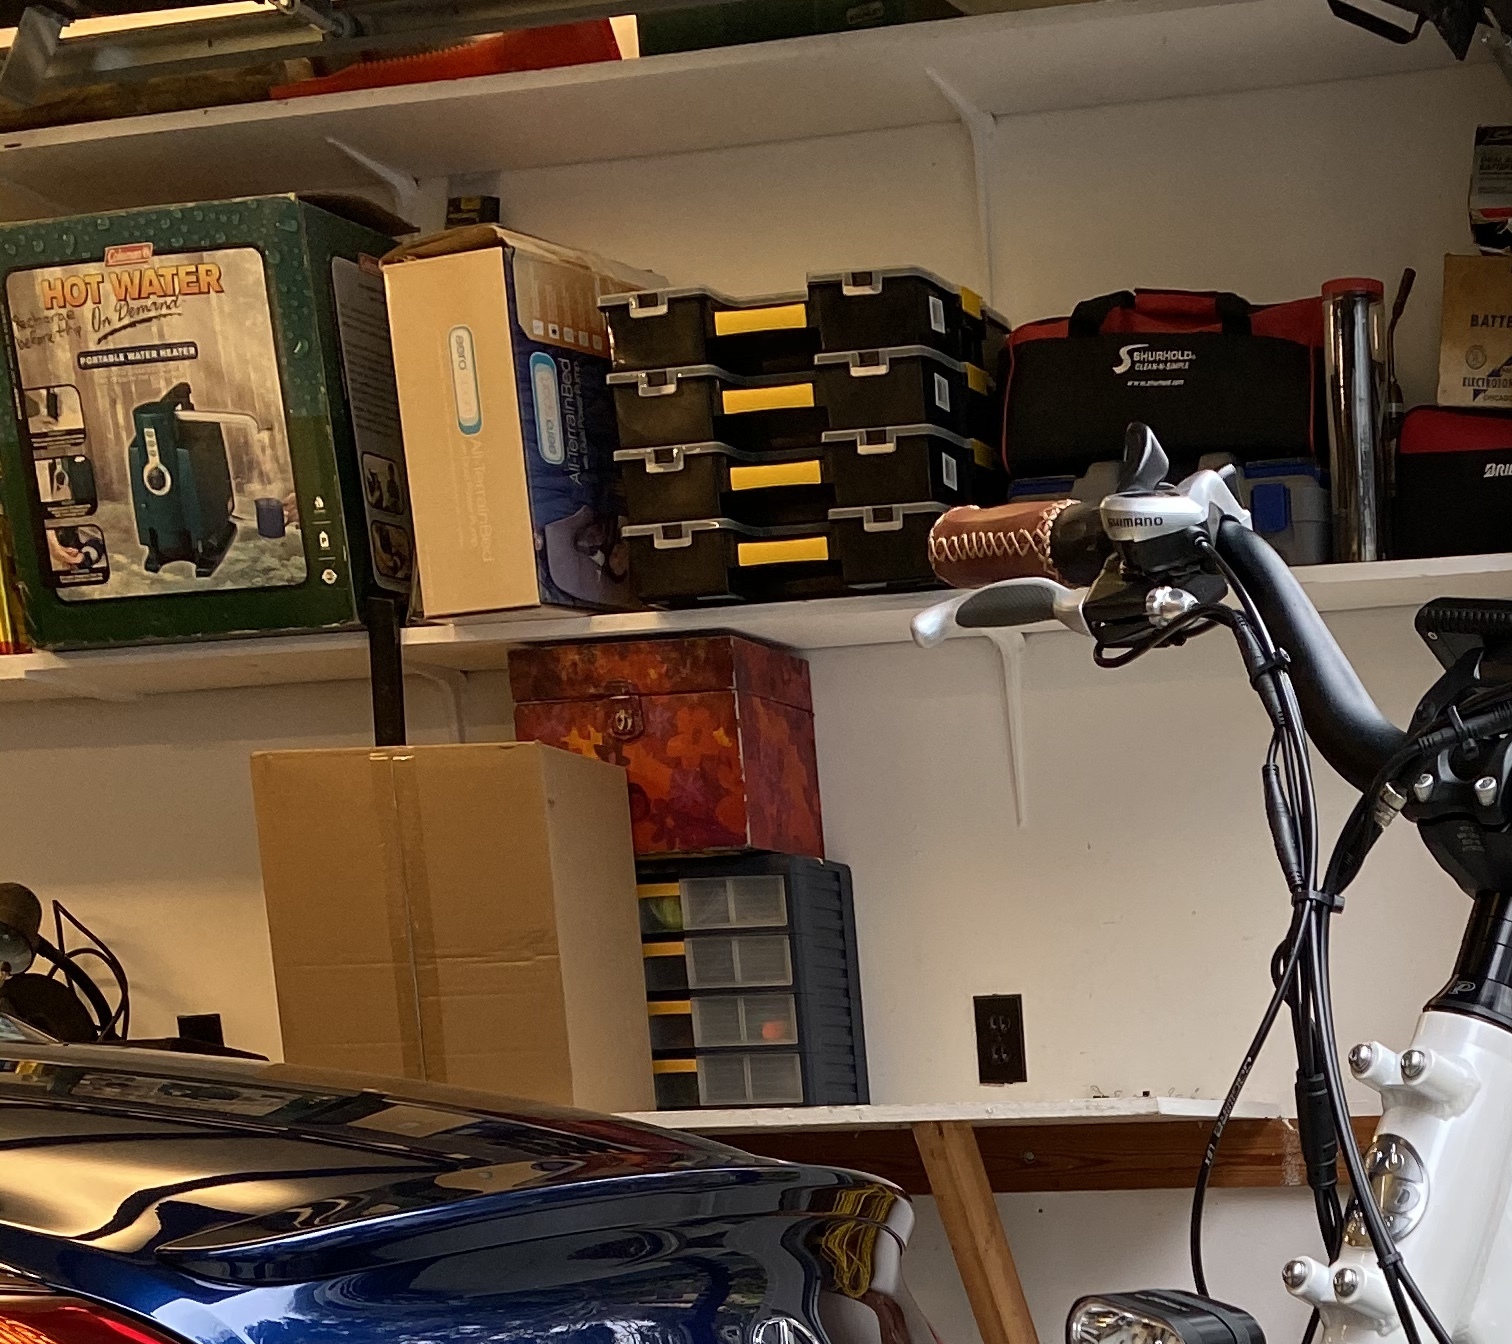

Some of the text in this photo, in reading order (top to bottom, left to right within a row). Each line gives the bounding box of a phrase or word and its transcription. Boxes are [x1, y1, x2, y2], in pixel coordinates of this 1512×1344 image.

[42, 262, 224, 310] HOT WATER
[91, 296, 180, 332] On Demand
[80, 346, 196, 366] PORTABLE WATER HEATER
[455, 334, 468, 371] aero
[1107, 517, 1163, 528] SHIMANO
